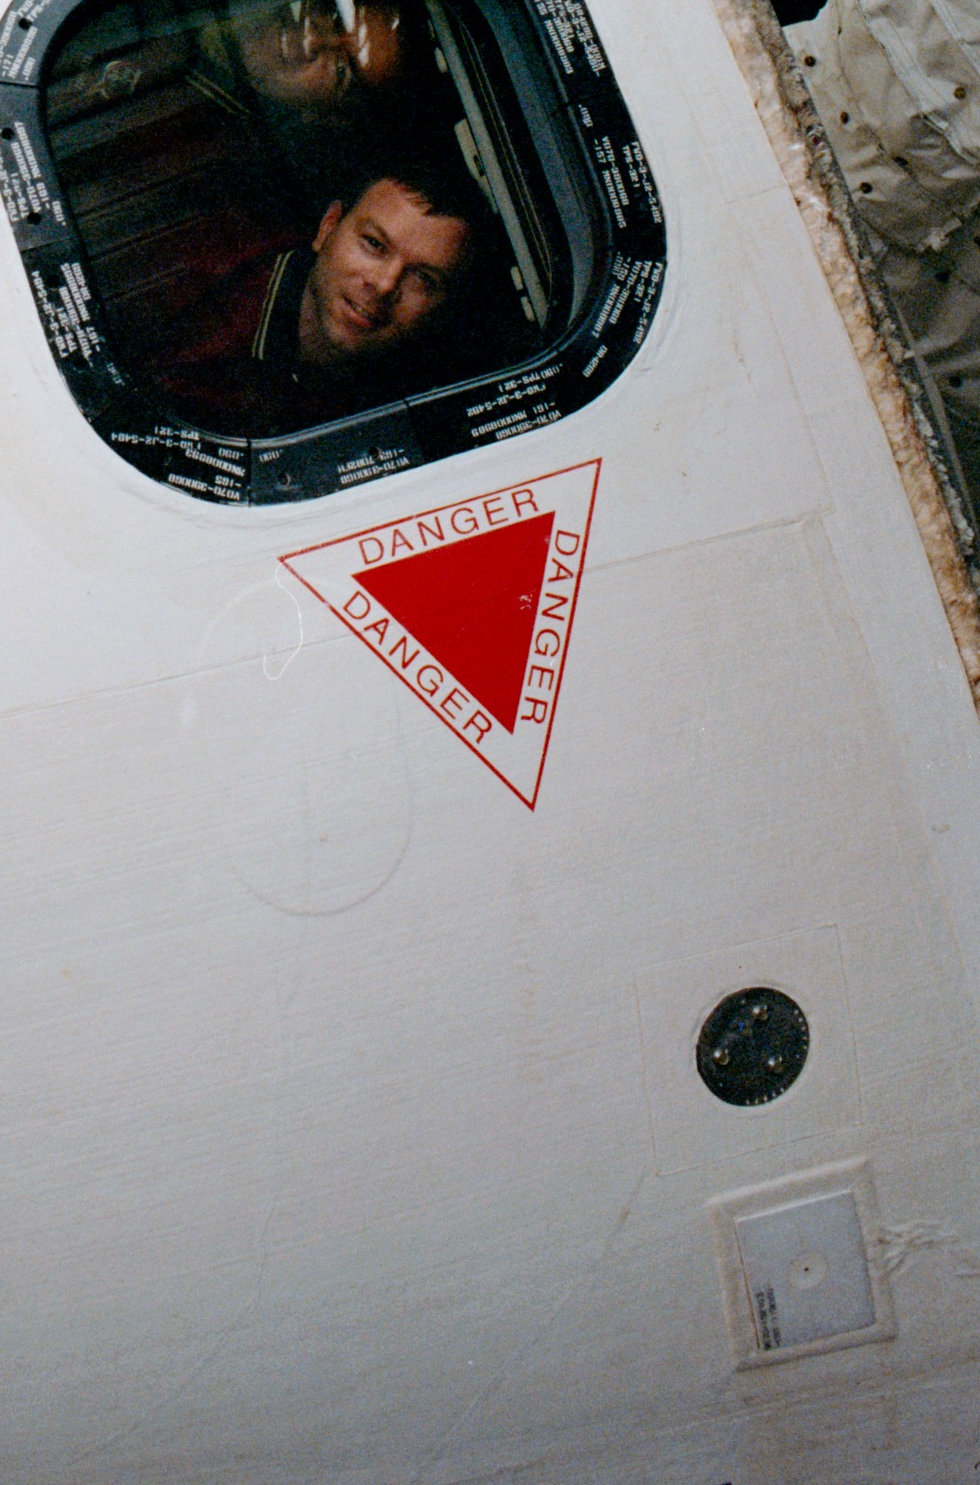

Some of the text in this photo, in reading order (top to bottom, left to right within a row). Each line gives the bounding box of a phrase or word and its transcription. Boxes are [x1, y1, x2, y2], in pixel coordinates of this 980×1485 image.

[358, 487, 539, 565] DANGER
[342, 590, 493, 745] DANGER
[520, 528, 580, 726] DANGER
